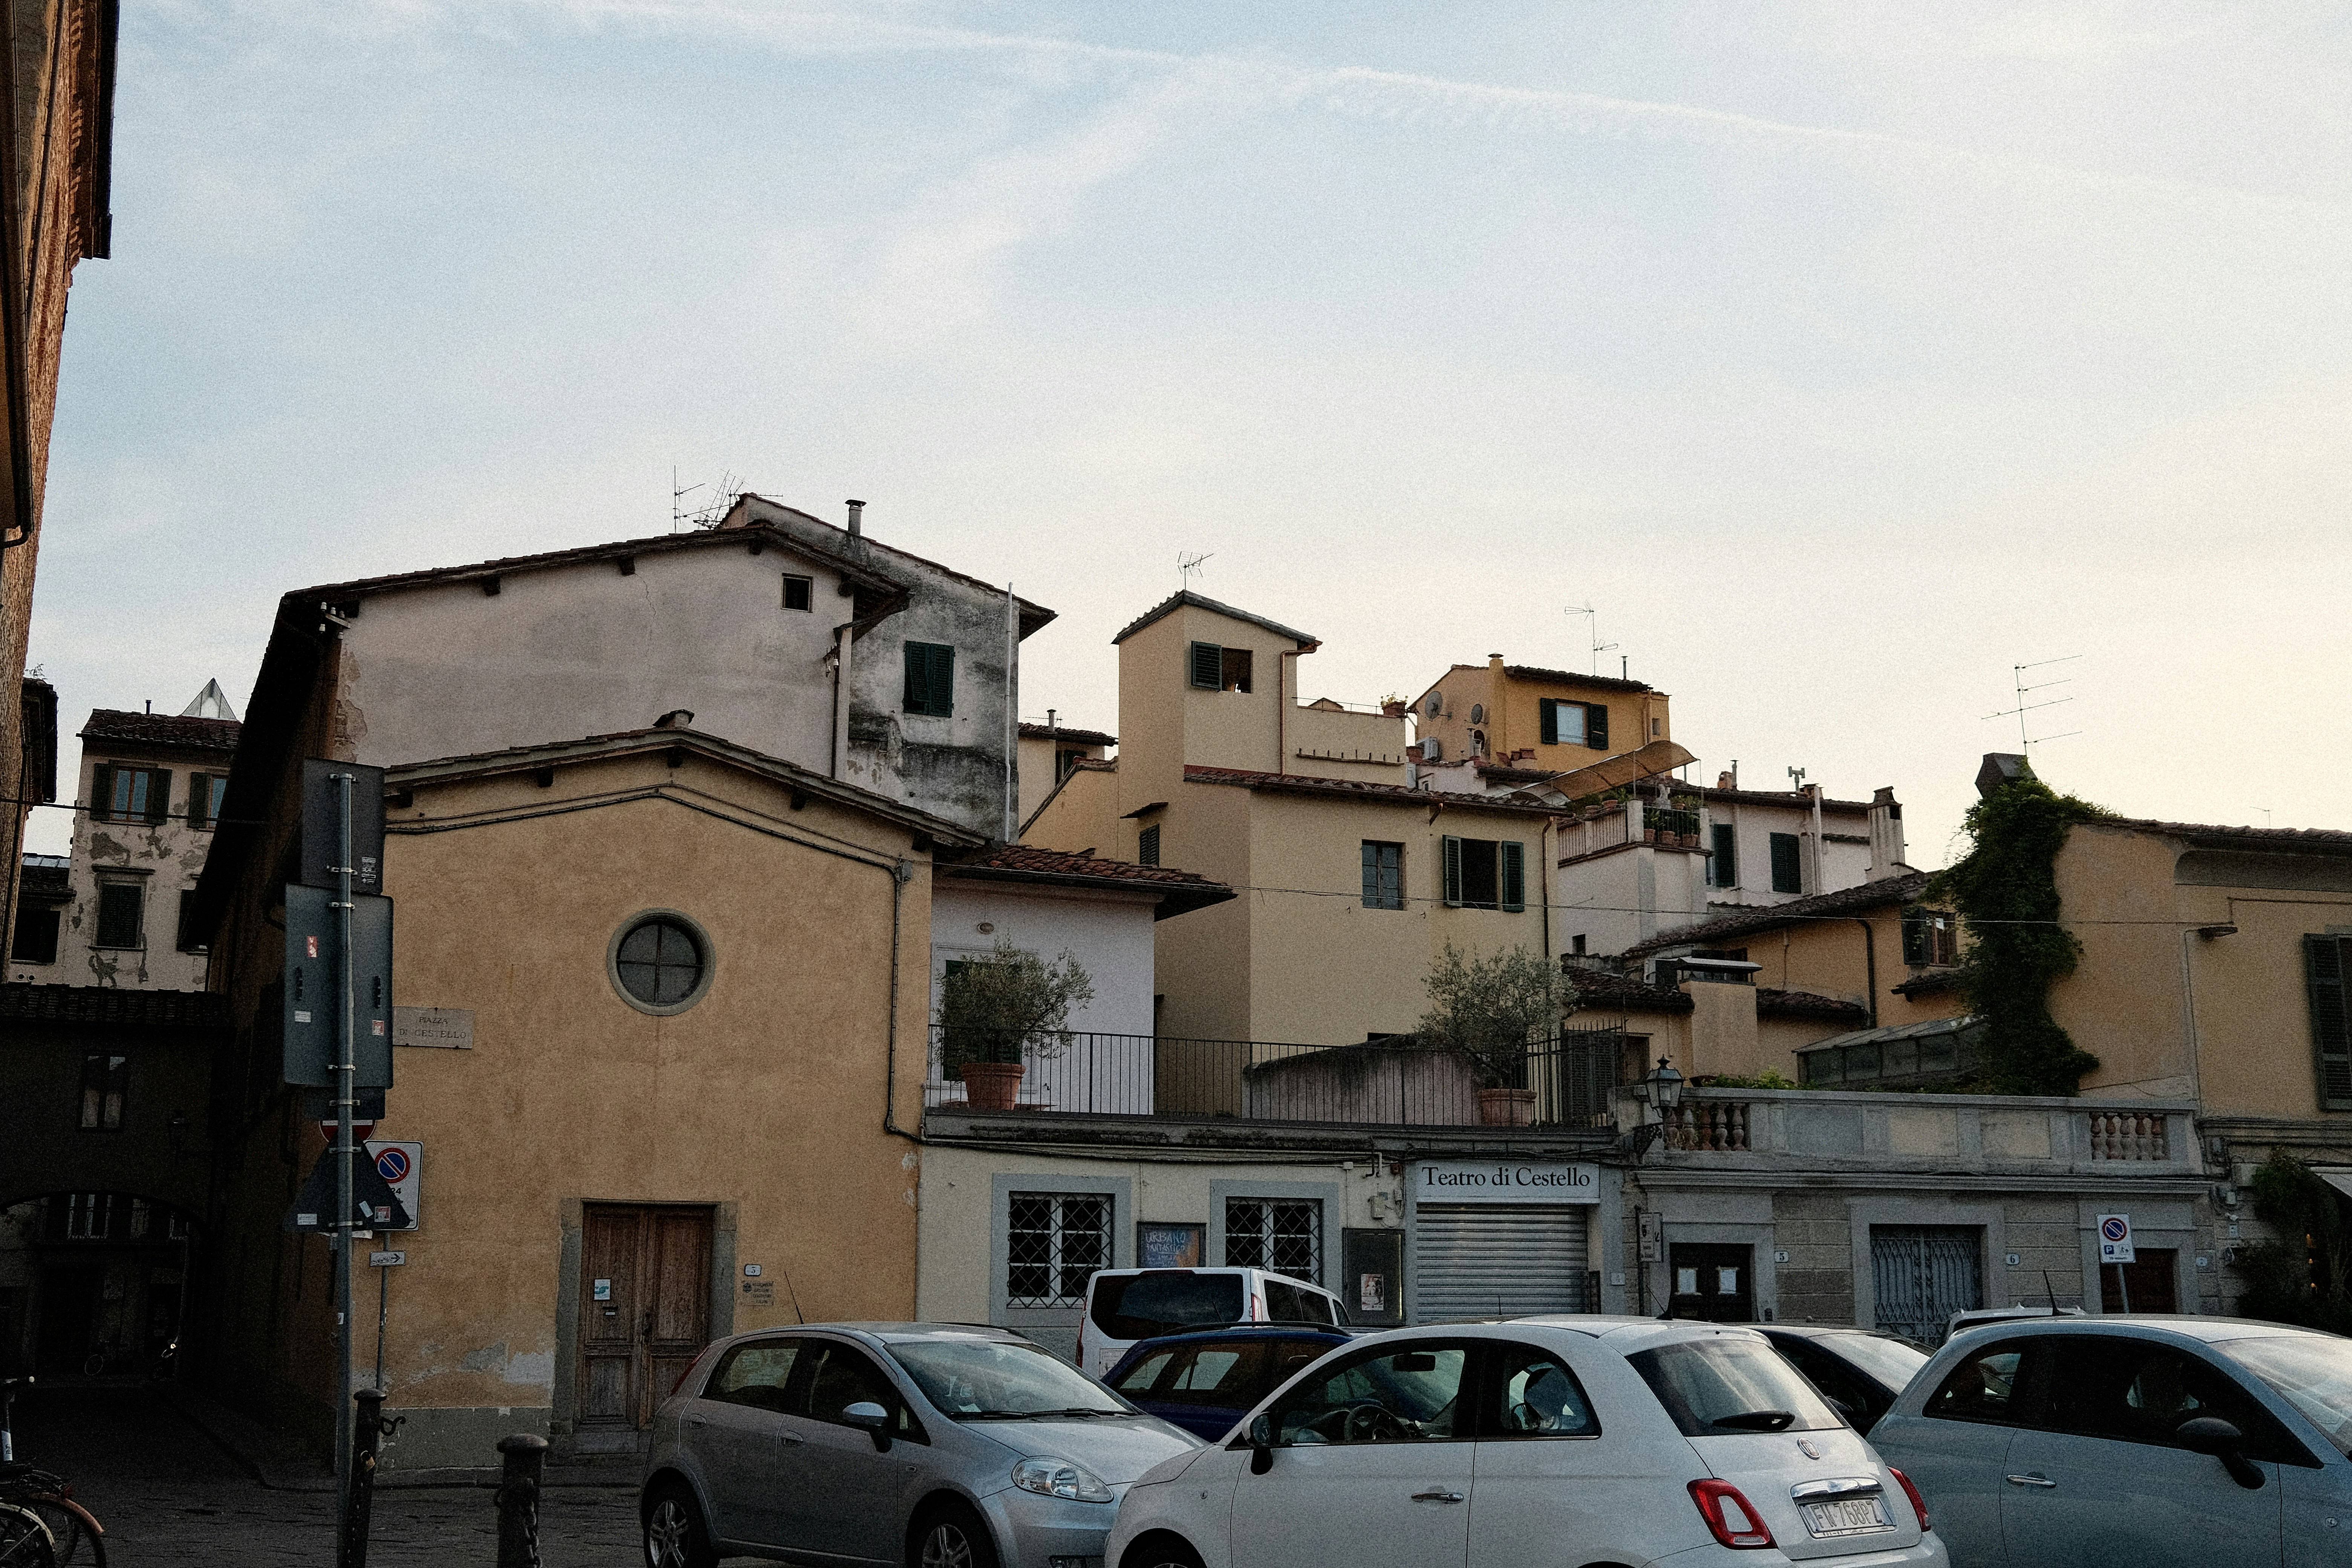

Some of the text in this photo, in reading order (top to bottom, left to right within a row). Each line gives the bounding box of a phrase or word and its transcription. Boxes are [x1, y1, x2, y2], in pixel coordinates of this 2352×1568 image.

[415, 1029, 467, 1038] CESTELLO
[1422, 1167, 1590, 1186] Teatro di Cestello
[1145, 1231, 1186, 1243] URBANO
[1146, 1243, 1185, 1252] FANTASTICO
[1779, 1253, 1784, 1261] 5
[2011, 1255, 2015, 1263] 6
